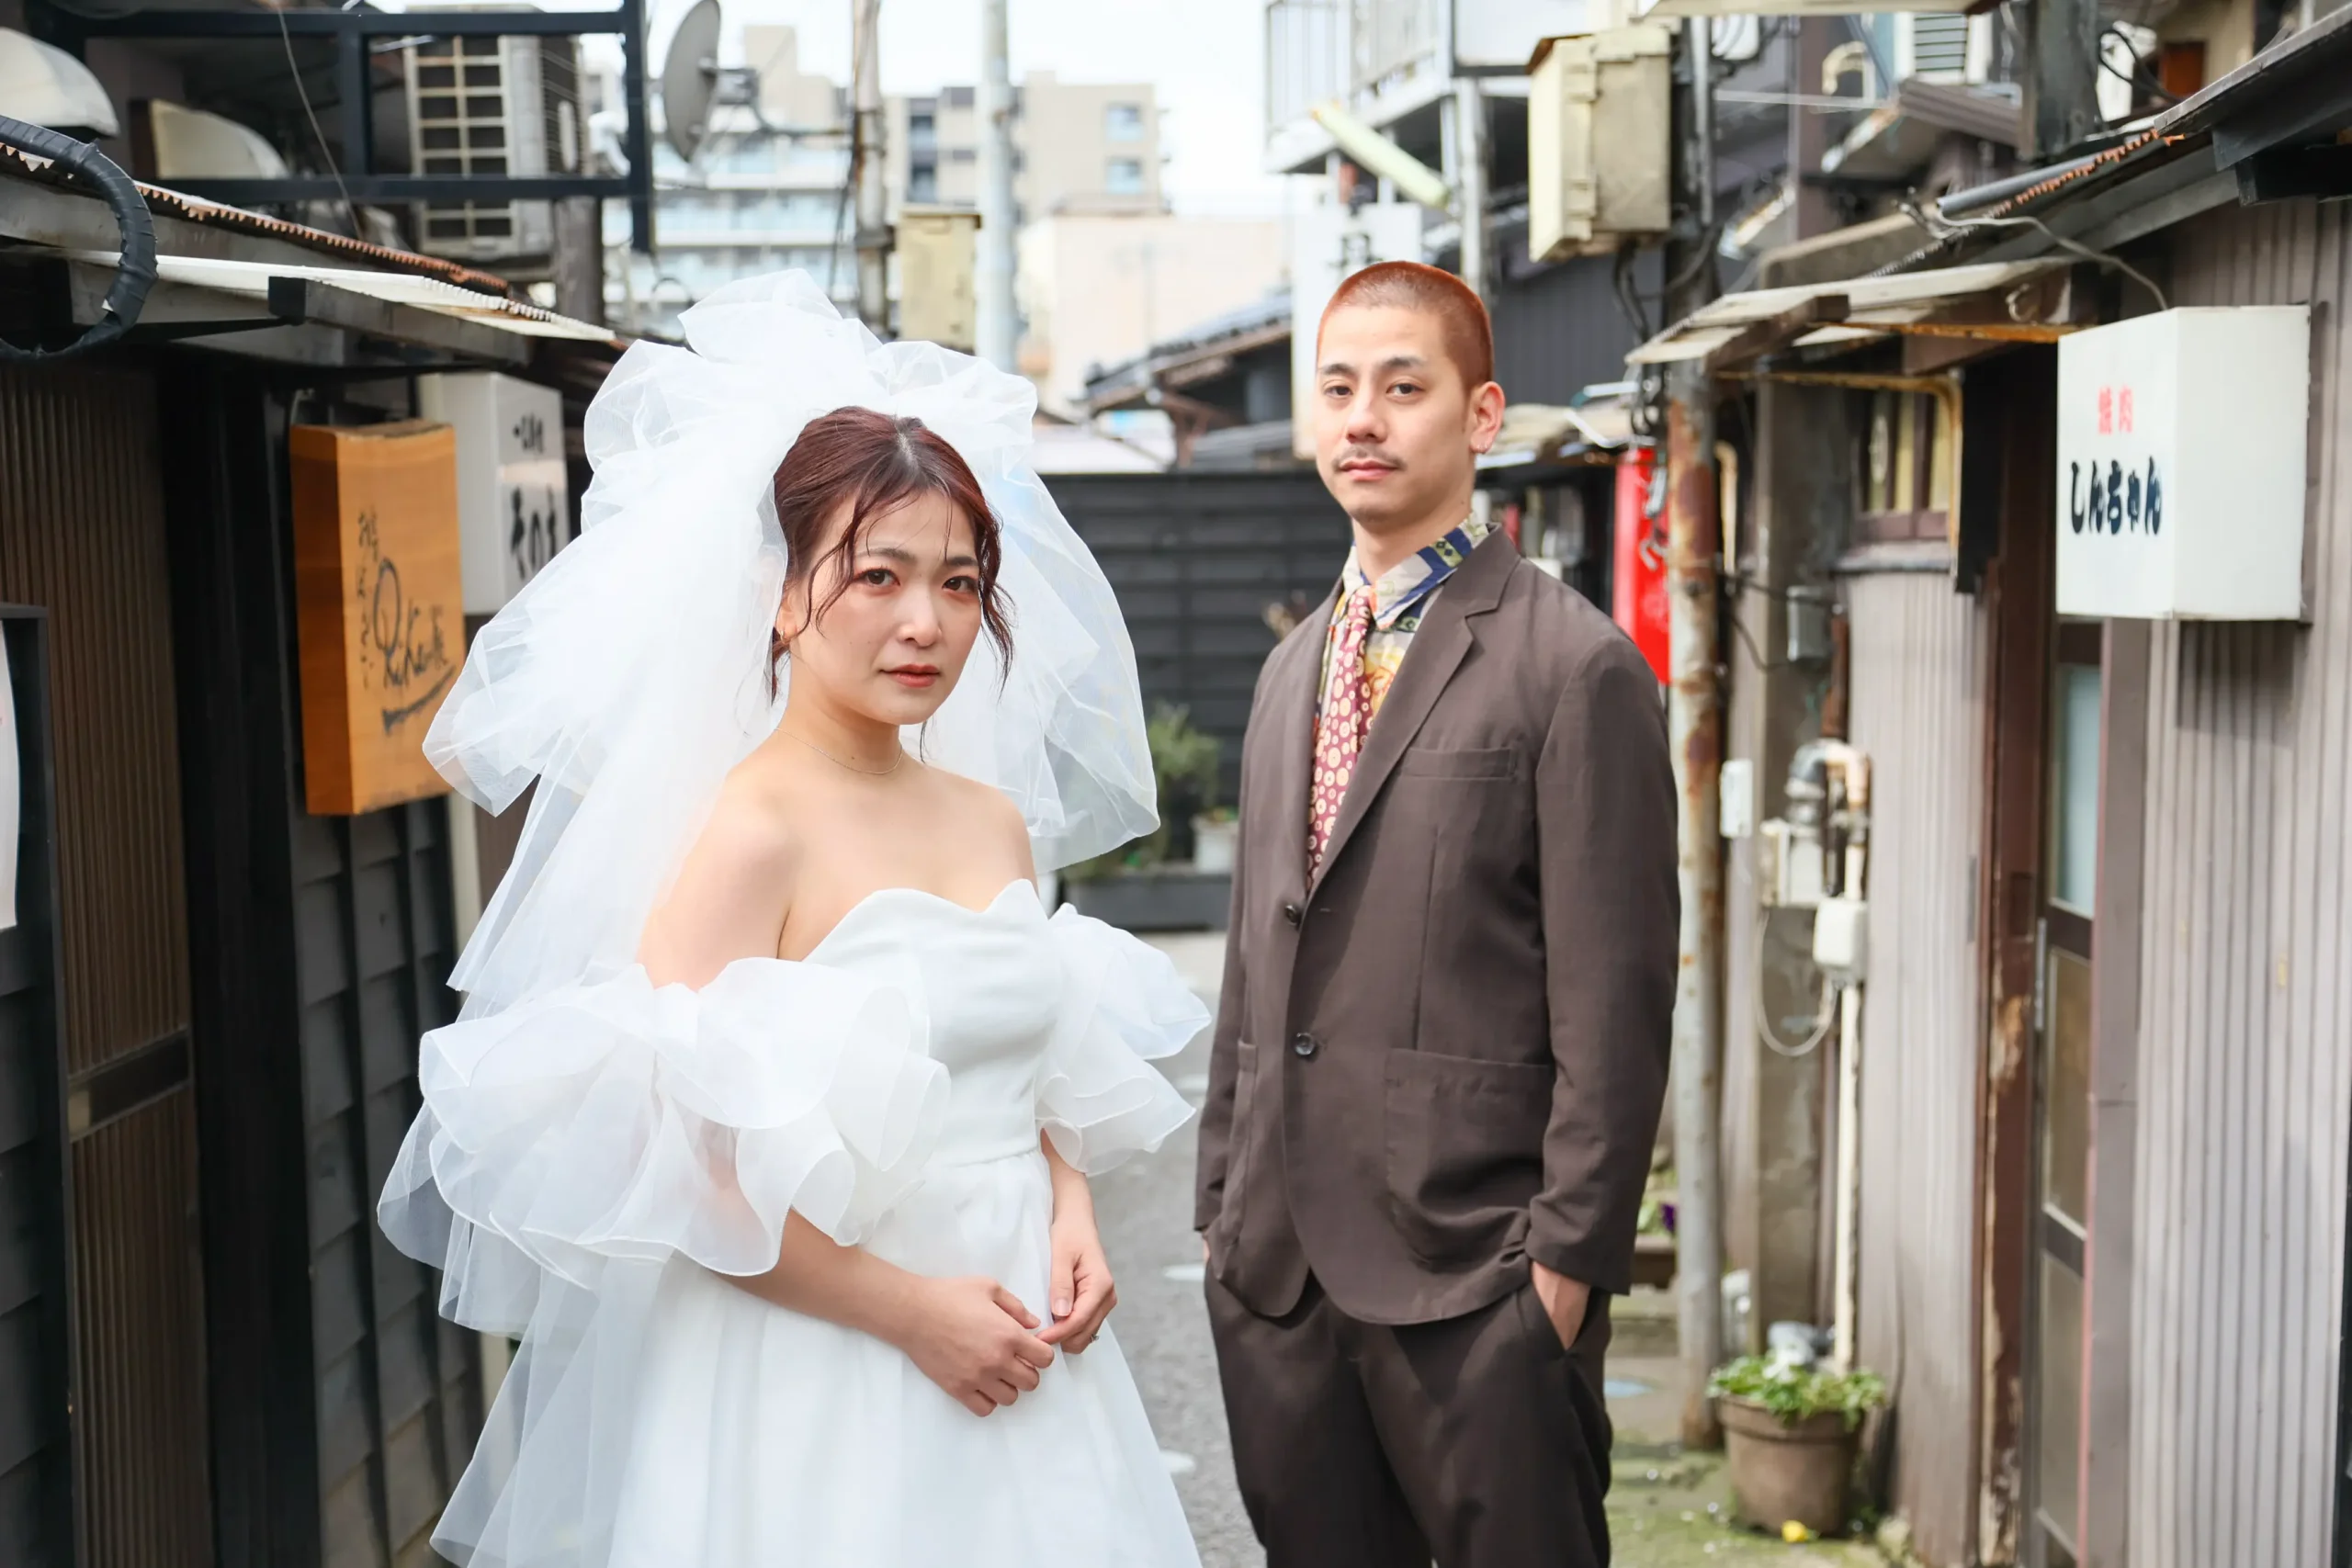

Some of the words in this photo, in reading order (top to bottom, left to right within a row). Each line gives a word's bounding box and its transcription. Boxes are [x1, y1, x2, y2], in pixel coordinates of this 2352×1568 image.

[2071, 456, 2161, 535] しんちゃん
